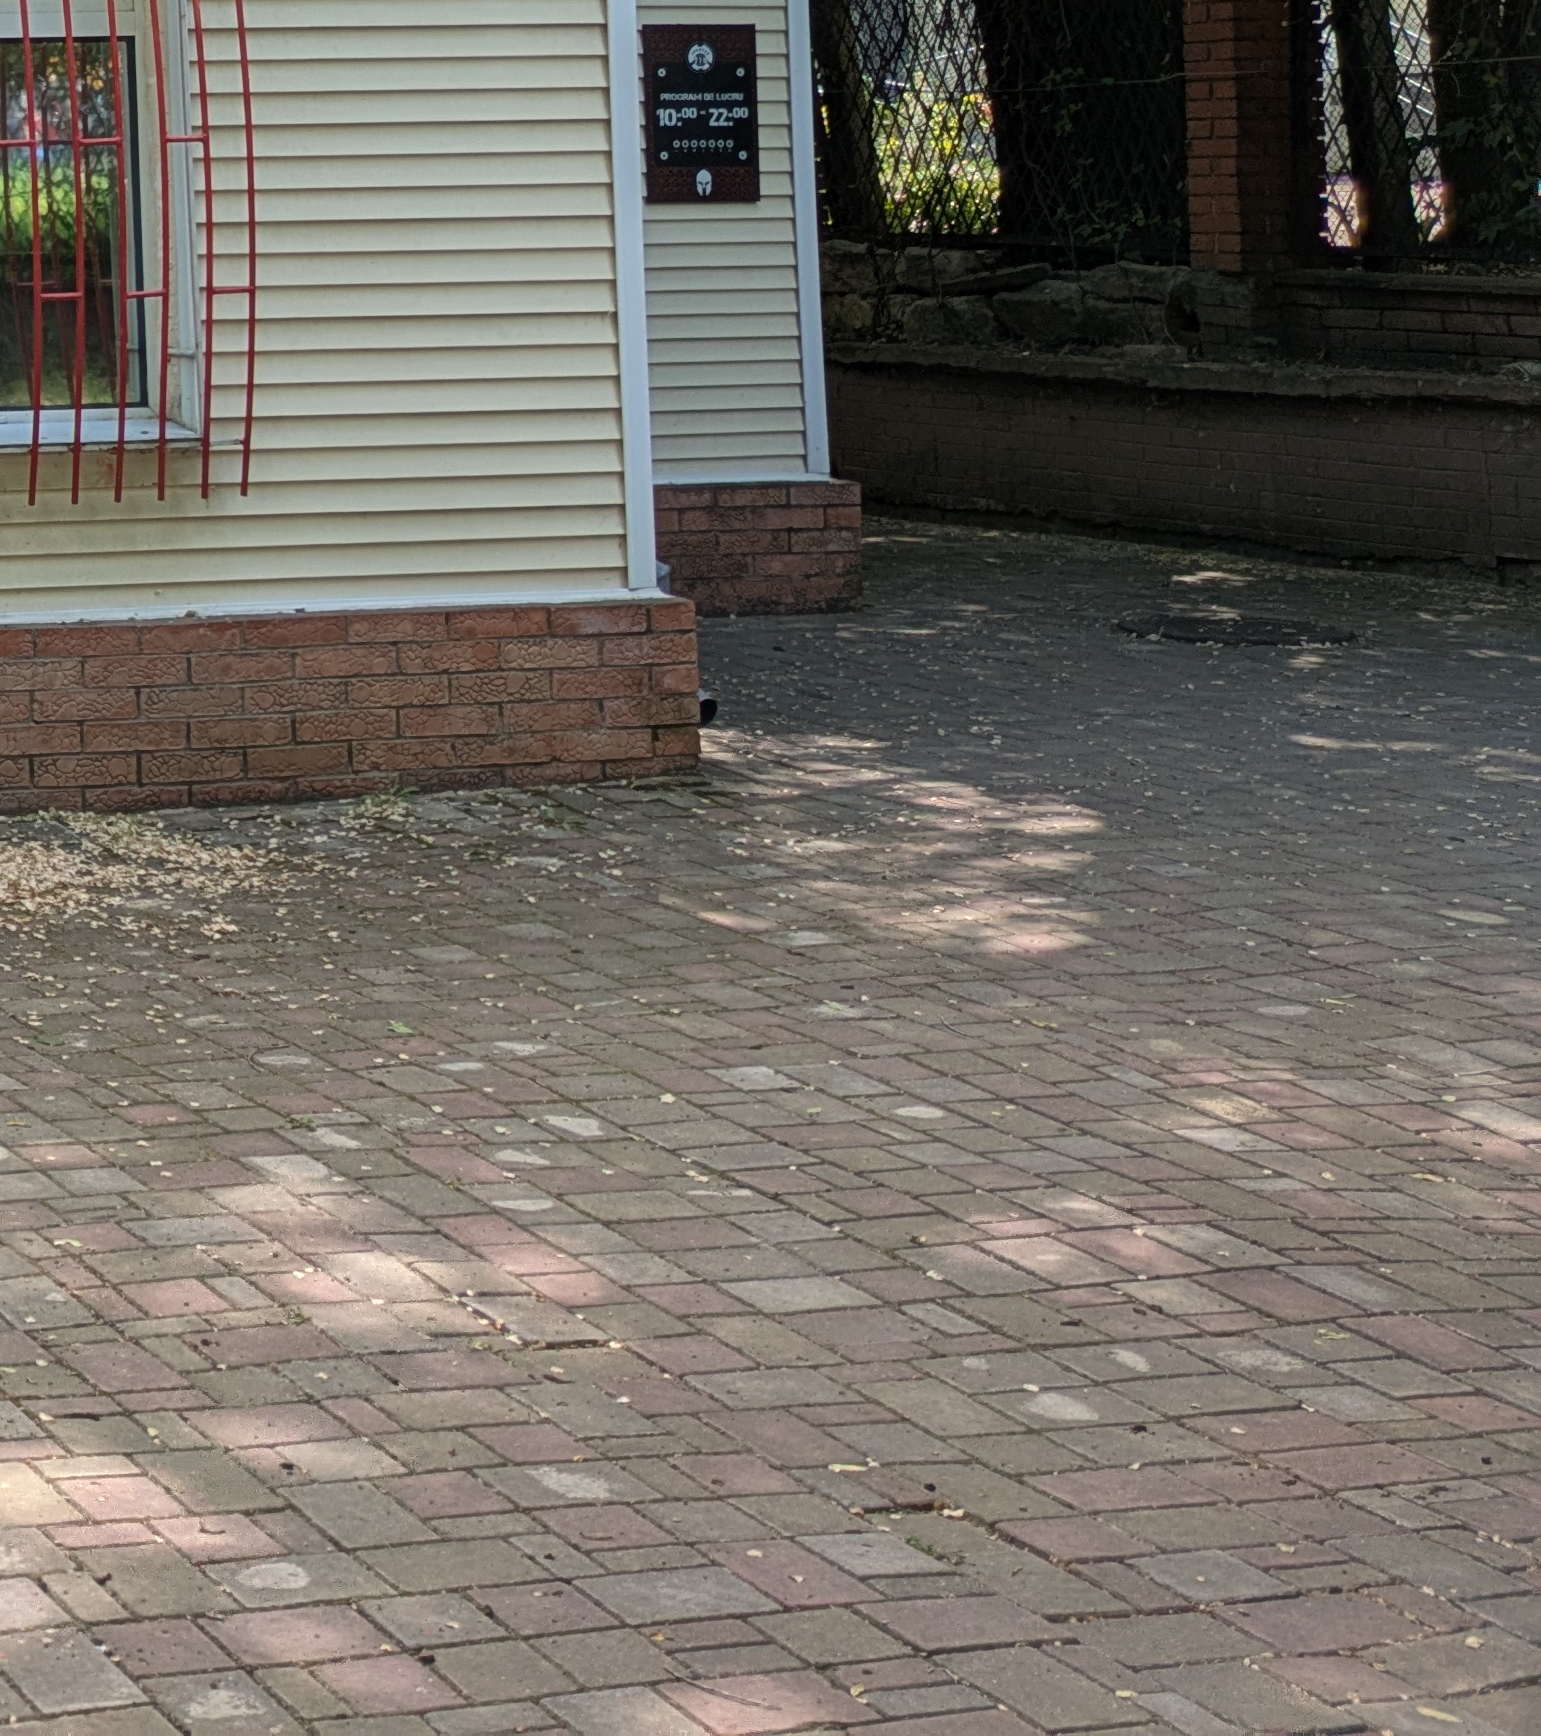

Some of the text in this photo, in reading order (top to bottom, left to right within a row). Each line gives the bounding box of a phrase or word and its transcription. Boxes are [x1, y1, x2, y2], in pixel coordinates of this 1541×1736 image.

[659, 93, 744, 101] PROGRAM DE LUCRU
